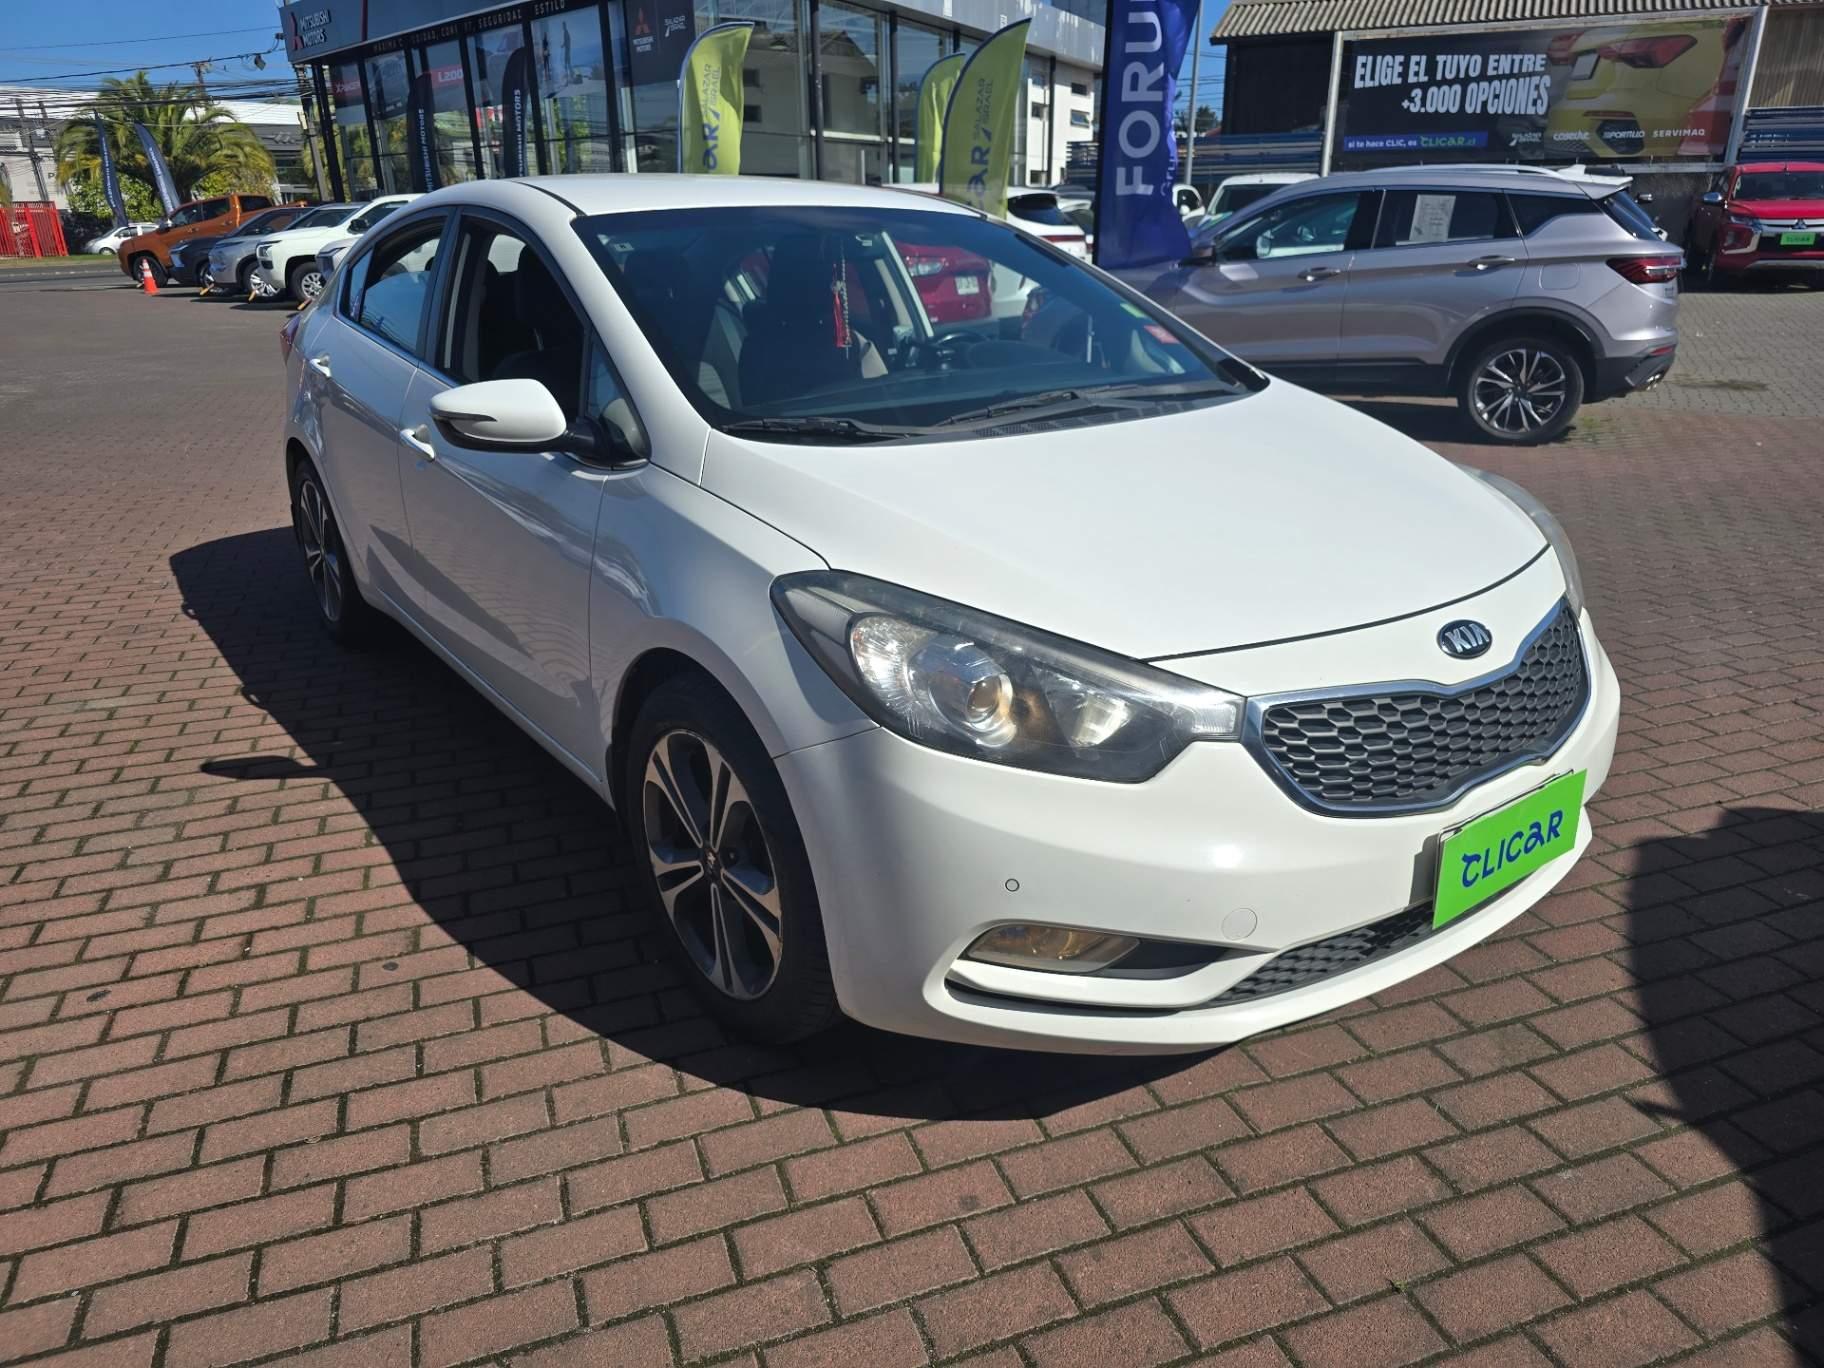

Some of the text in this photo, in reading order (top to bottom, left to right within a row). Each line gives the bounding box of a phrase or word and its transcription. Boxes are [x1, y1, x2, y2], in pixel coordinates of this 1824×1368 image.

[1354, 53, 1547, 89] ELIGE EL TUYO ENTRE
[1115, 0, 1165, 196] FORU
[1401, 75, 1551, 116] +3.000 OPCIONES
[1652, 128, 1706, 138] SERVIMAQ
